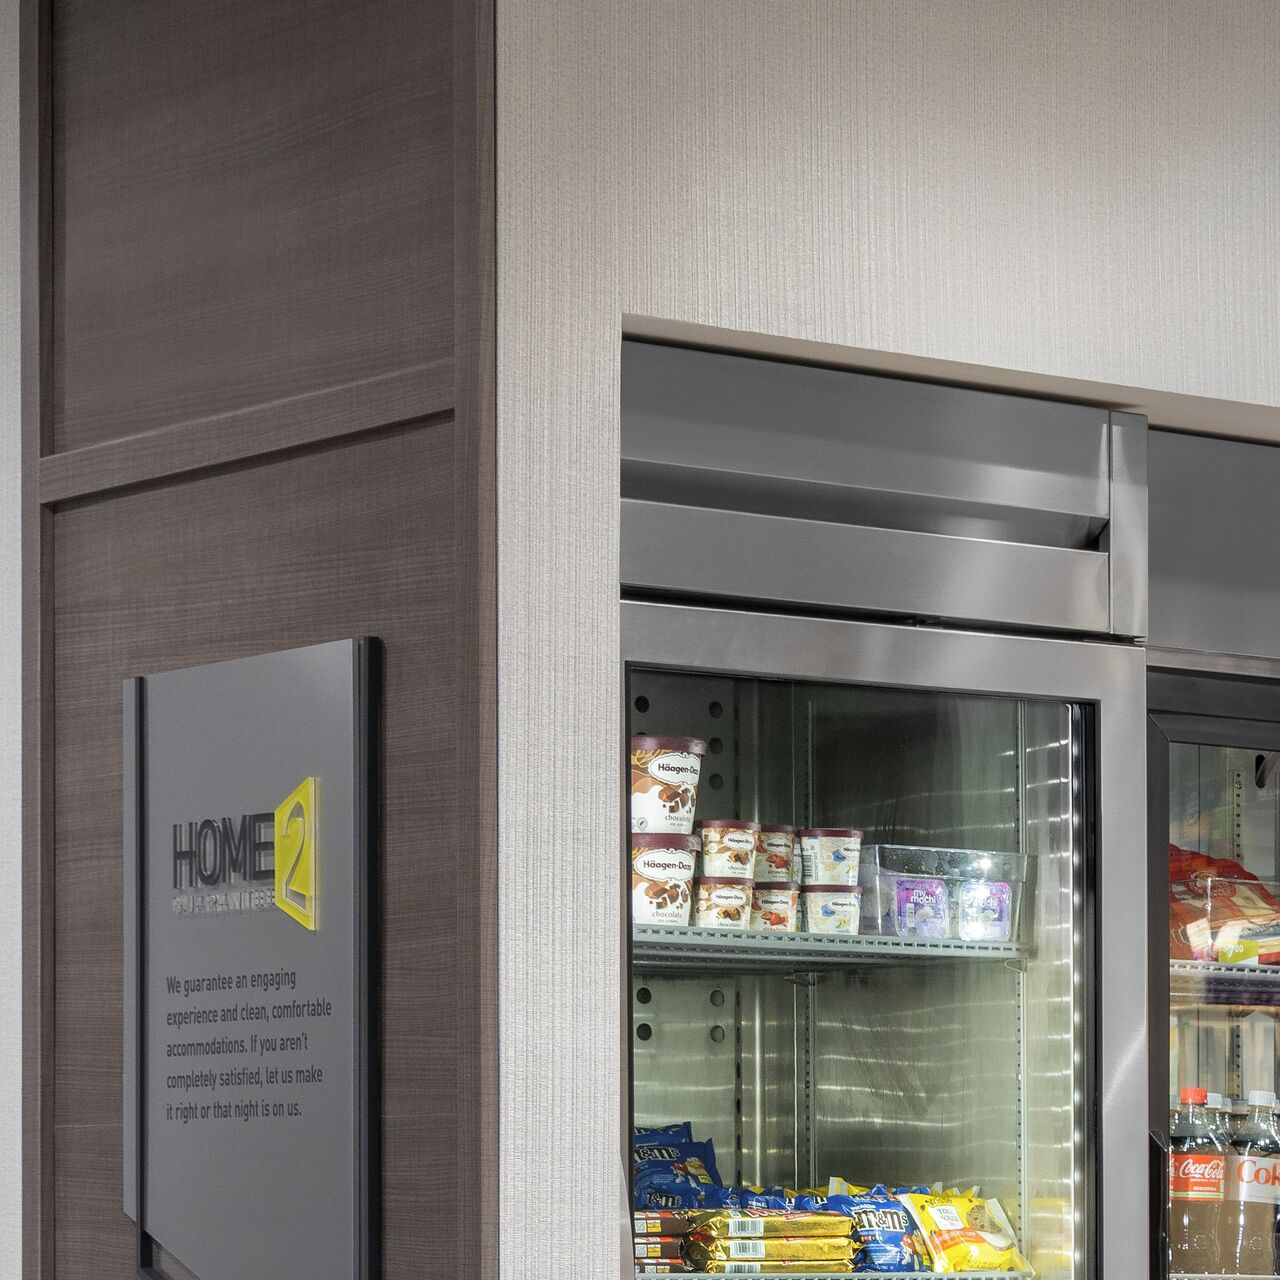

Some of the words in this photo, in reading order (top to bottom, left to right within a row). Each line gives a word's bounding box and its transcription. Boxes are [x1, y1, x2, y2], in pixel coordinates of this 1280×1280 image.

[173, 812, 275, 889] HOME
[166, 976, 181, 994] We
[184, 974, 233, 997] guarantee
[236, 975, 248, 989] an
[251, 968, 296, 991] engaging
[167, 1006, 218, 1029] experience
[220, 1003, 238, 1023] and
[241, 1003, 269, 1022] clean,
[272, 998, 332, 1019] comfortable
[167, 1036, 248, 1057] accommodations.
[250, 1034, 257, 1053] If
[260, 1037, 277, 1056] you
[167, 1069, 217, 1092] completely
[219, 1067, 263, 1087] satisfied,
[266, 1066, 278, 1085] let
[281, 1069, 293, 1084] us
[295, 1064, 323, 1083] make
[166, 1103, 173, 1120] it
[175, 1102, 198, 1124] right
[200, 1105, 211, 1119] or
[213, 1101, 232, 1118] that
[235, 1100, 258, 1122] night
[262, 1100, 269, 1117] is
[273, 1103, 284, 1117] on
[287, 1102, 302, 1116] us.
